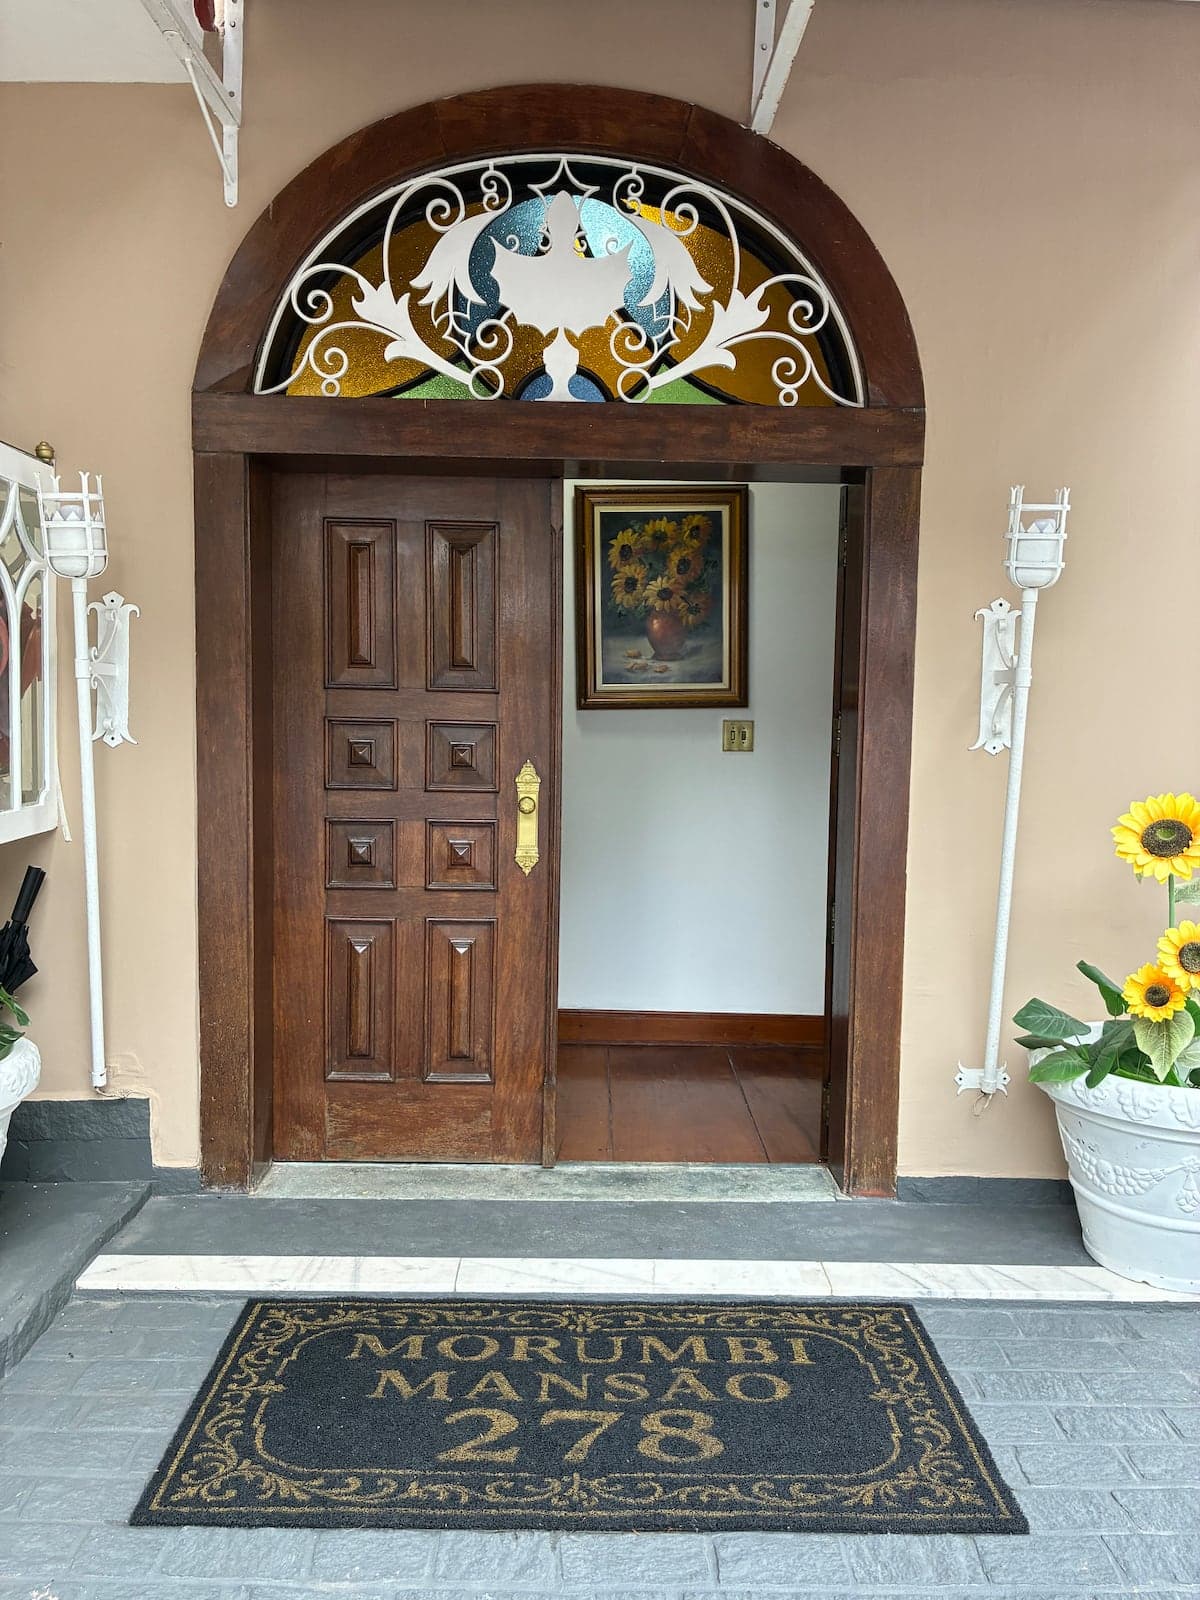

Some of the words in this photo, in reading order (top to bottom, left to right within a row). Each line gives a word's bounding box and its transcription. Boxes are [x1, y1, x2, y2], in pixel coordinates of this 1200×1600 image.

[347, 1333, 816, 1365] MORUMBI
[367, 1367, 792, 1401] MANSÃO
[435, 1407, 725, 1464] 278
